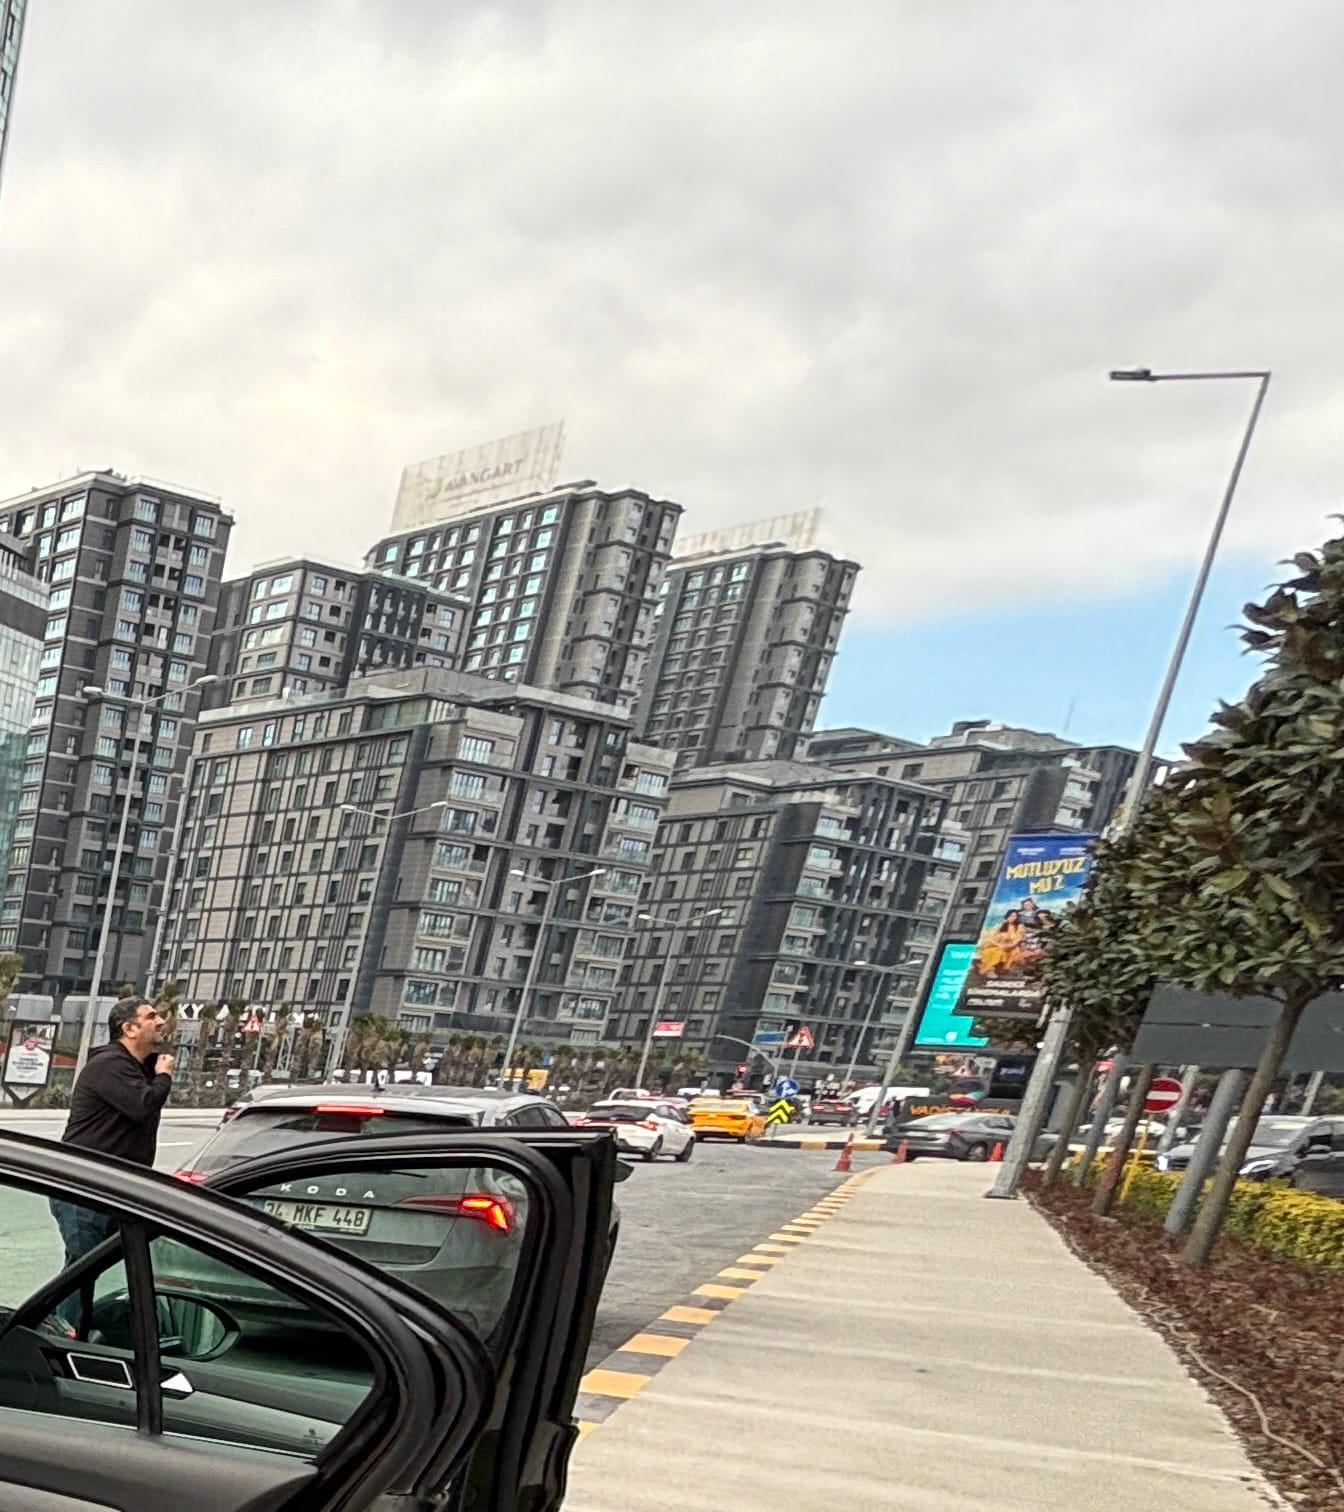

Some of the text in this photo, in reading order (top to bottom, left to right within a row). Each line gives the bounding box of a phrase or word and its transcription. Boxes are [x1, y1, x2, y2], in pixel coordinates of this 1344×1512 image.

[445, 458, 525, 492] AVANGART
[280, 1183, 375, 1199] KODA
[293, 1204, 327, 1223] MKF
[333, 1208, 365, 1228] 448
